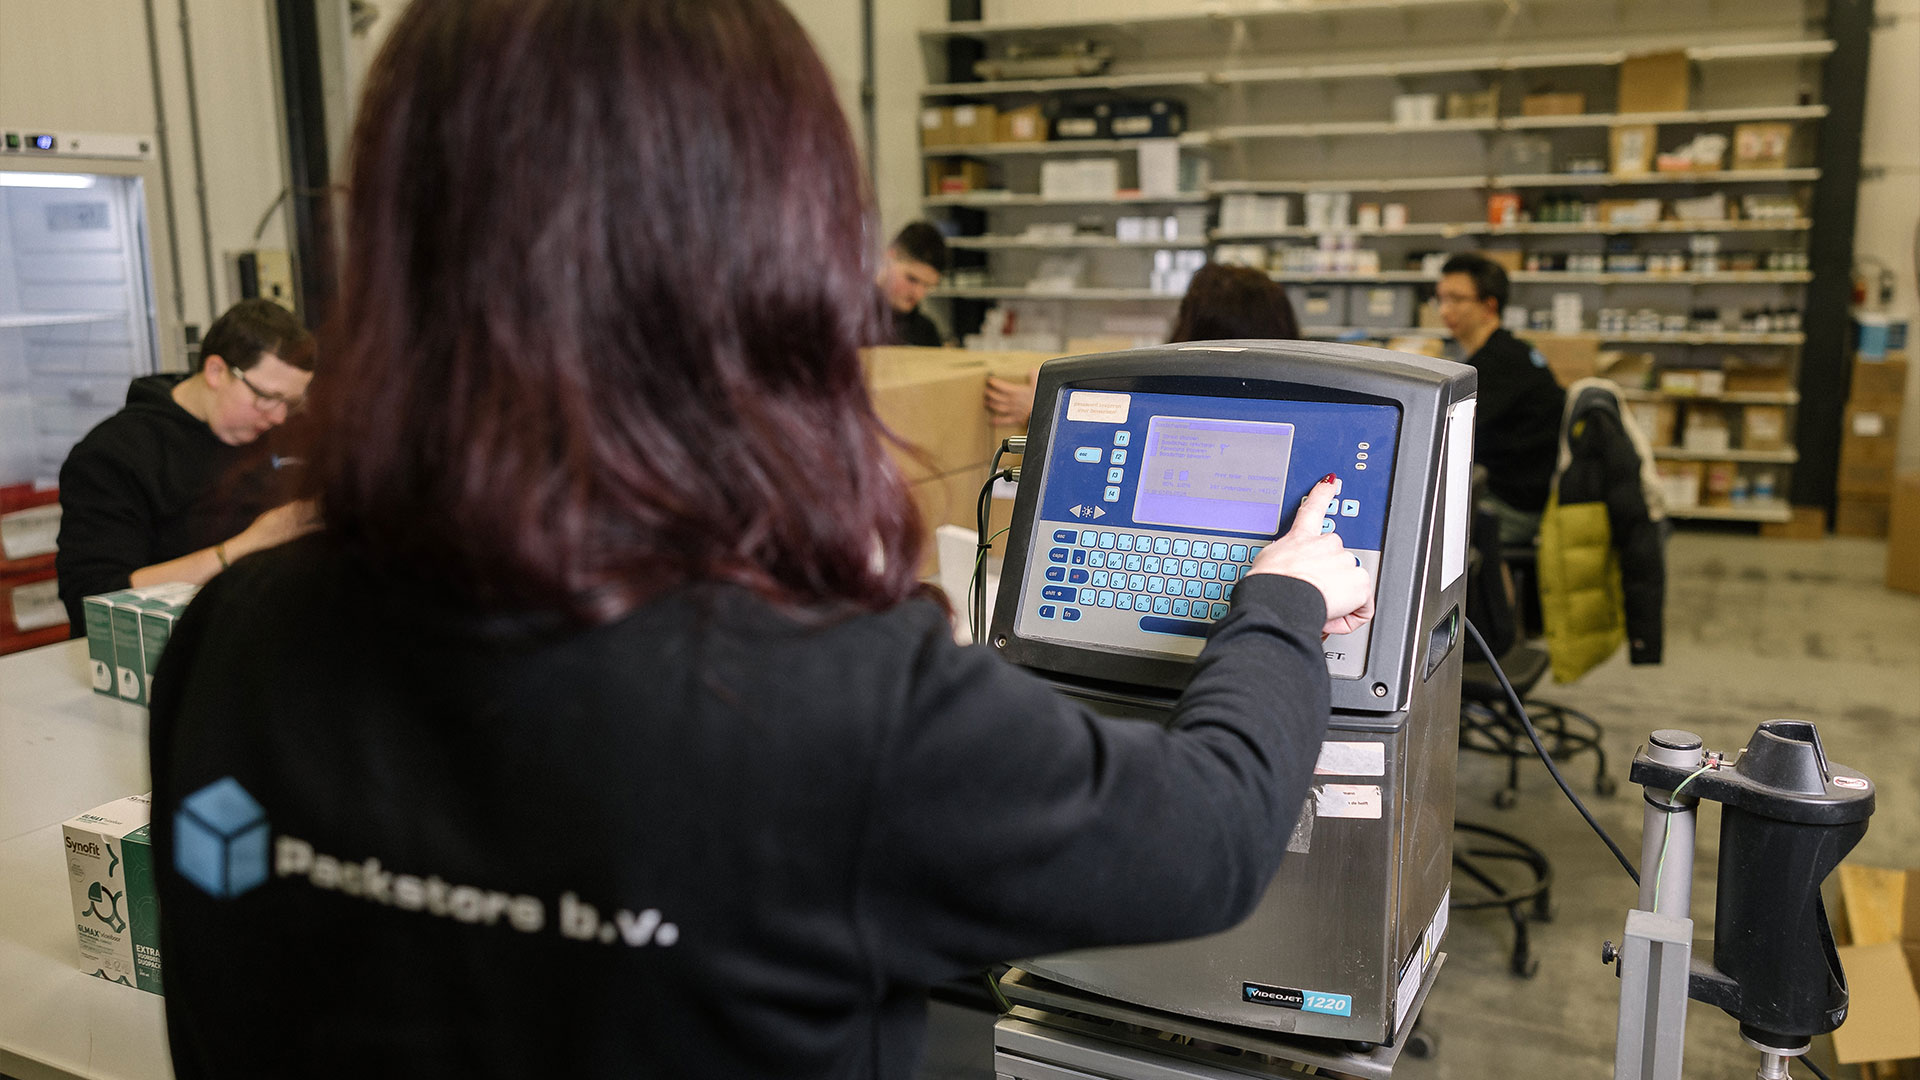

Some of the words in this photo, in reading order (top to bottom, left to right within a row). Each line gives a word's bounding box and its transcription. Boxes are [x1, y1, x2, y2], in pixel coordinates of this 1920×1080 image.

[65, 836, 100, 856] Synofit
[274, 835, 545, 933] Packstore
[559, 890, 679, 947] b.v.
[136, 944, 160, 958] EXTRA
[1252, 990, 1302, 1003] VIDEOJET
[1306, 996, 1346, 1011] 1220
